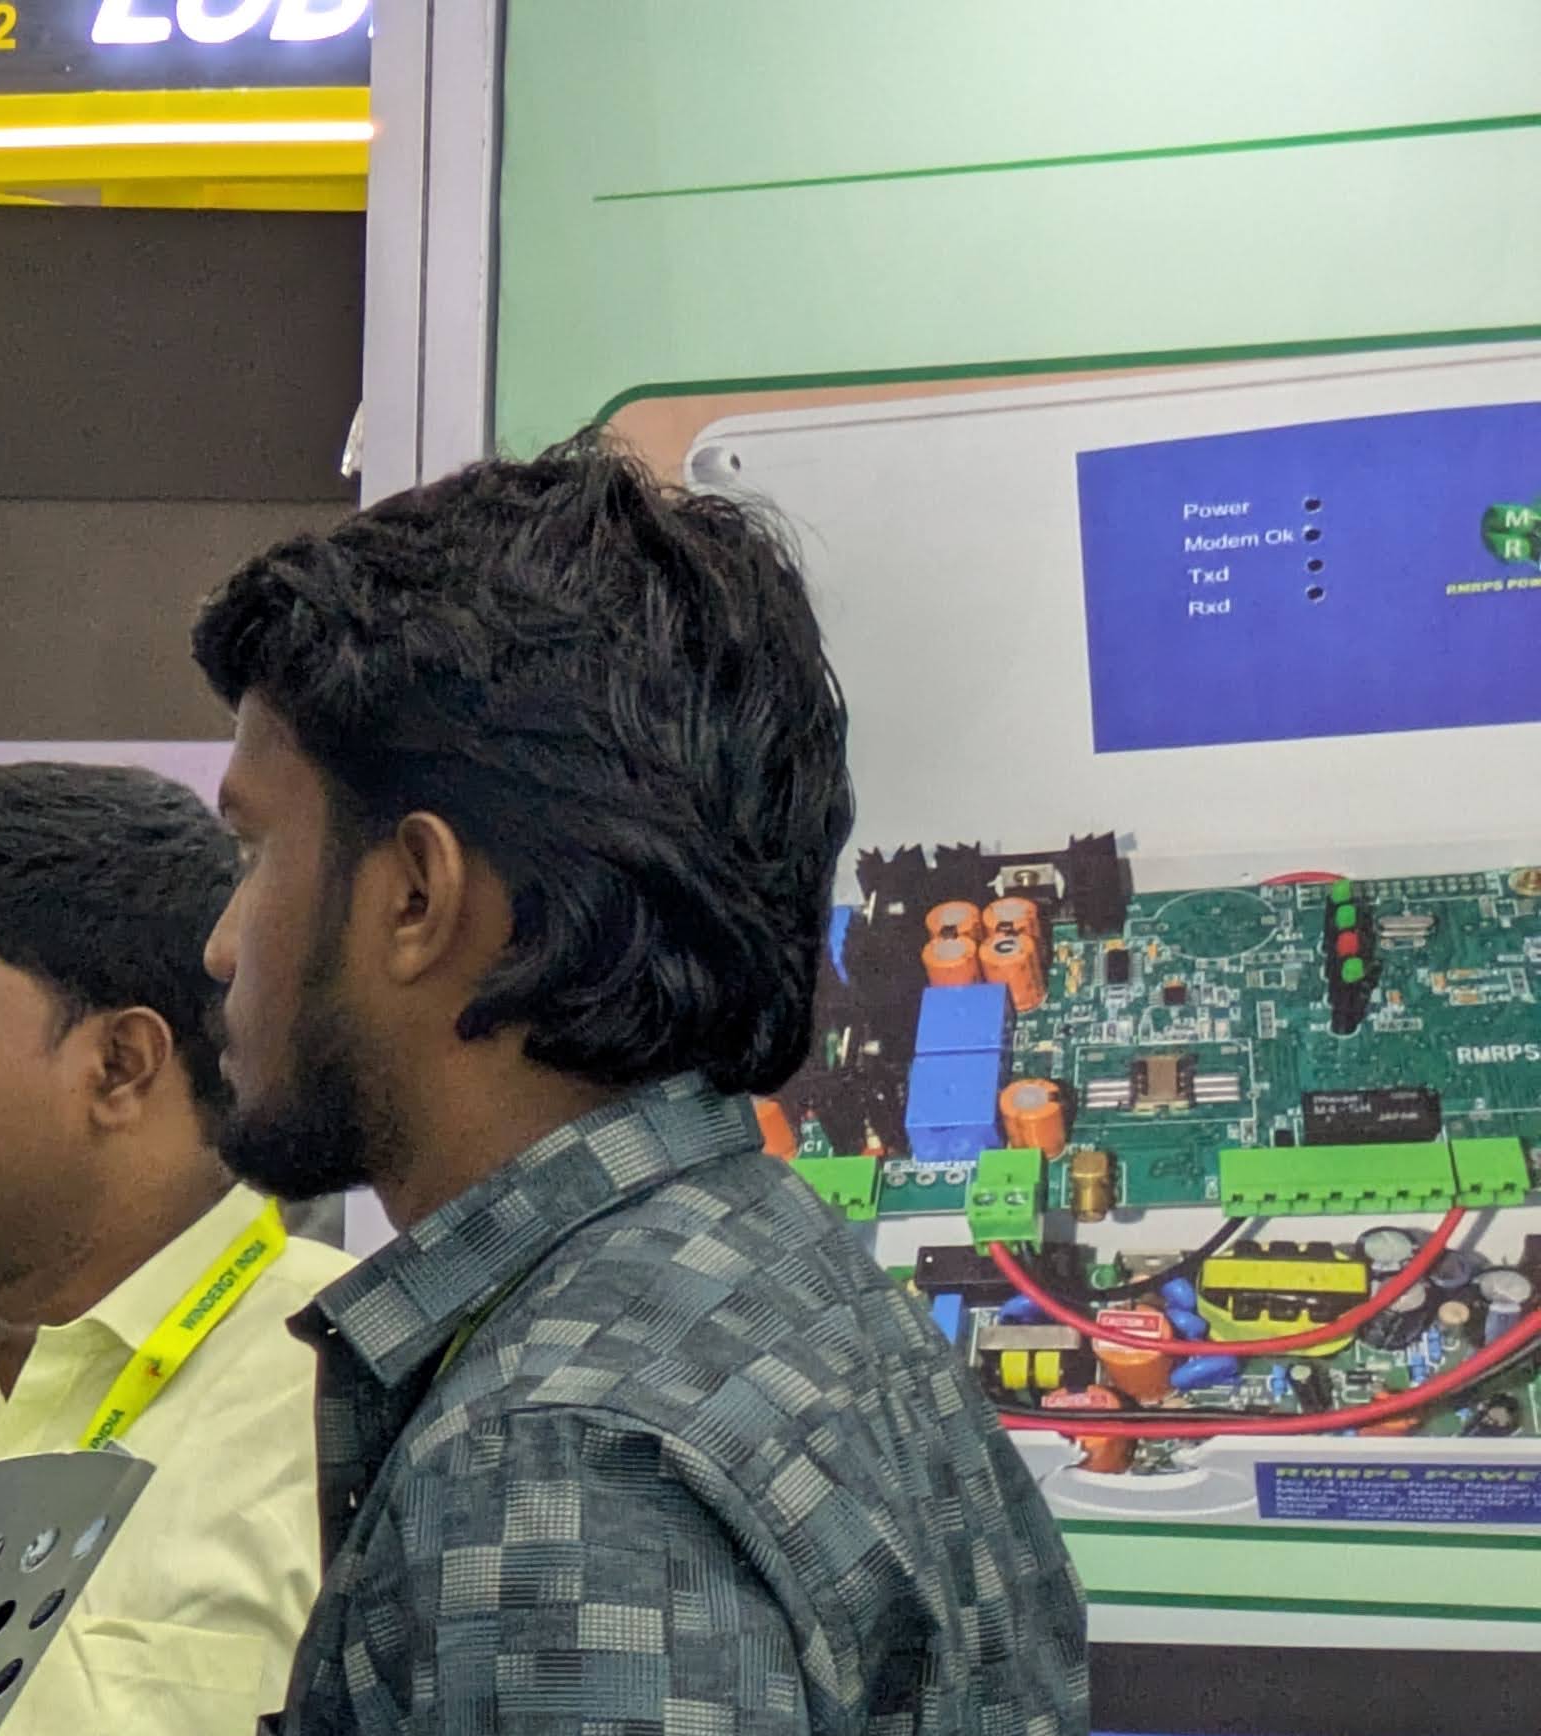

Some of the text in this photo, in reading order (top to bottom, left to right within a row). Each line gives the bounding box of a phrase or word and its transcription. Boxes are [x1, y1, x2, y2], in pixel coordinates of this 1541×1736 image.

[1183, 500, 1250, 520] Power
[1184, 528, 1294, 552] Modem Ok
[1188, 566, 1230, 584] Txd
[1189, 598, 1231, 617] Rxd
[1457, 1044, 1540, 1065] RMRPS
